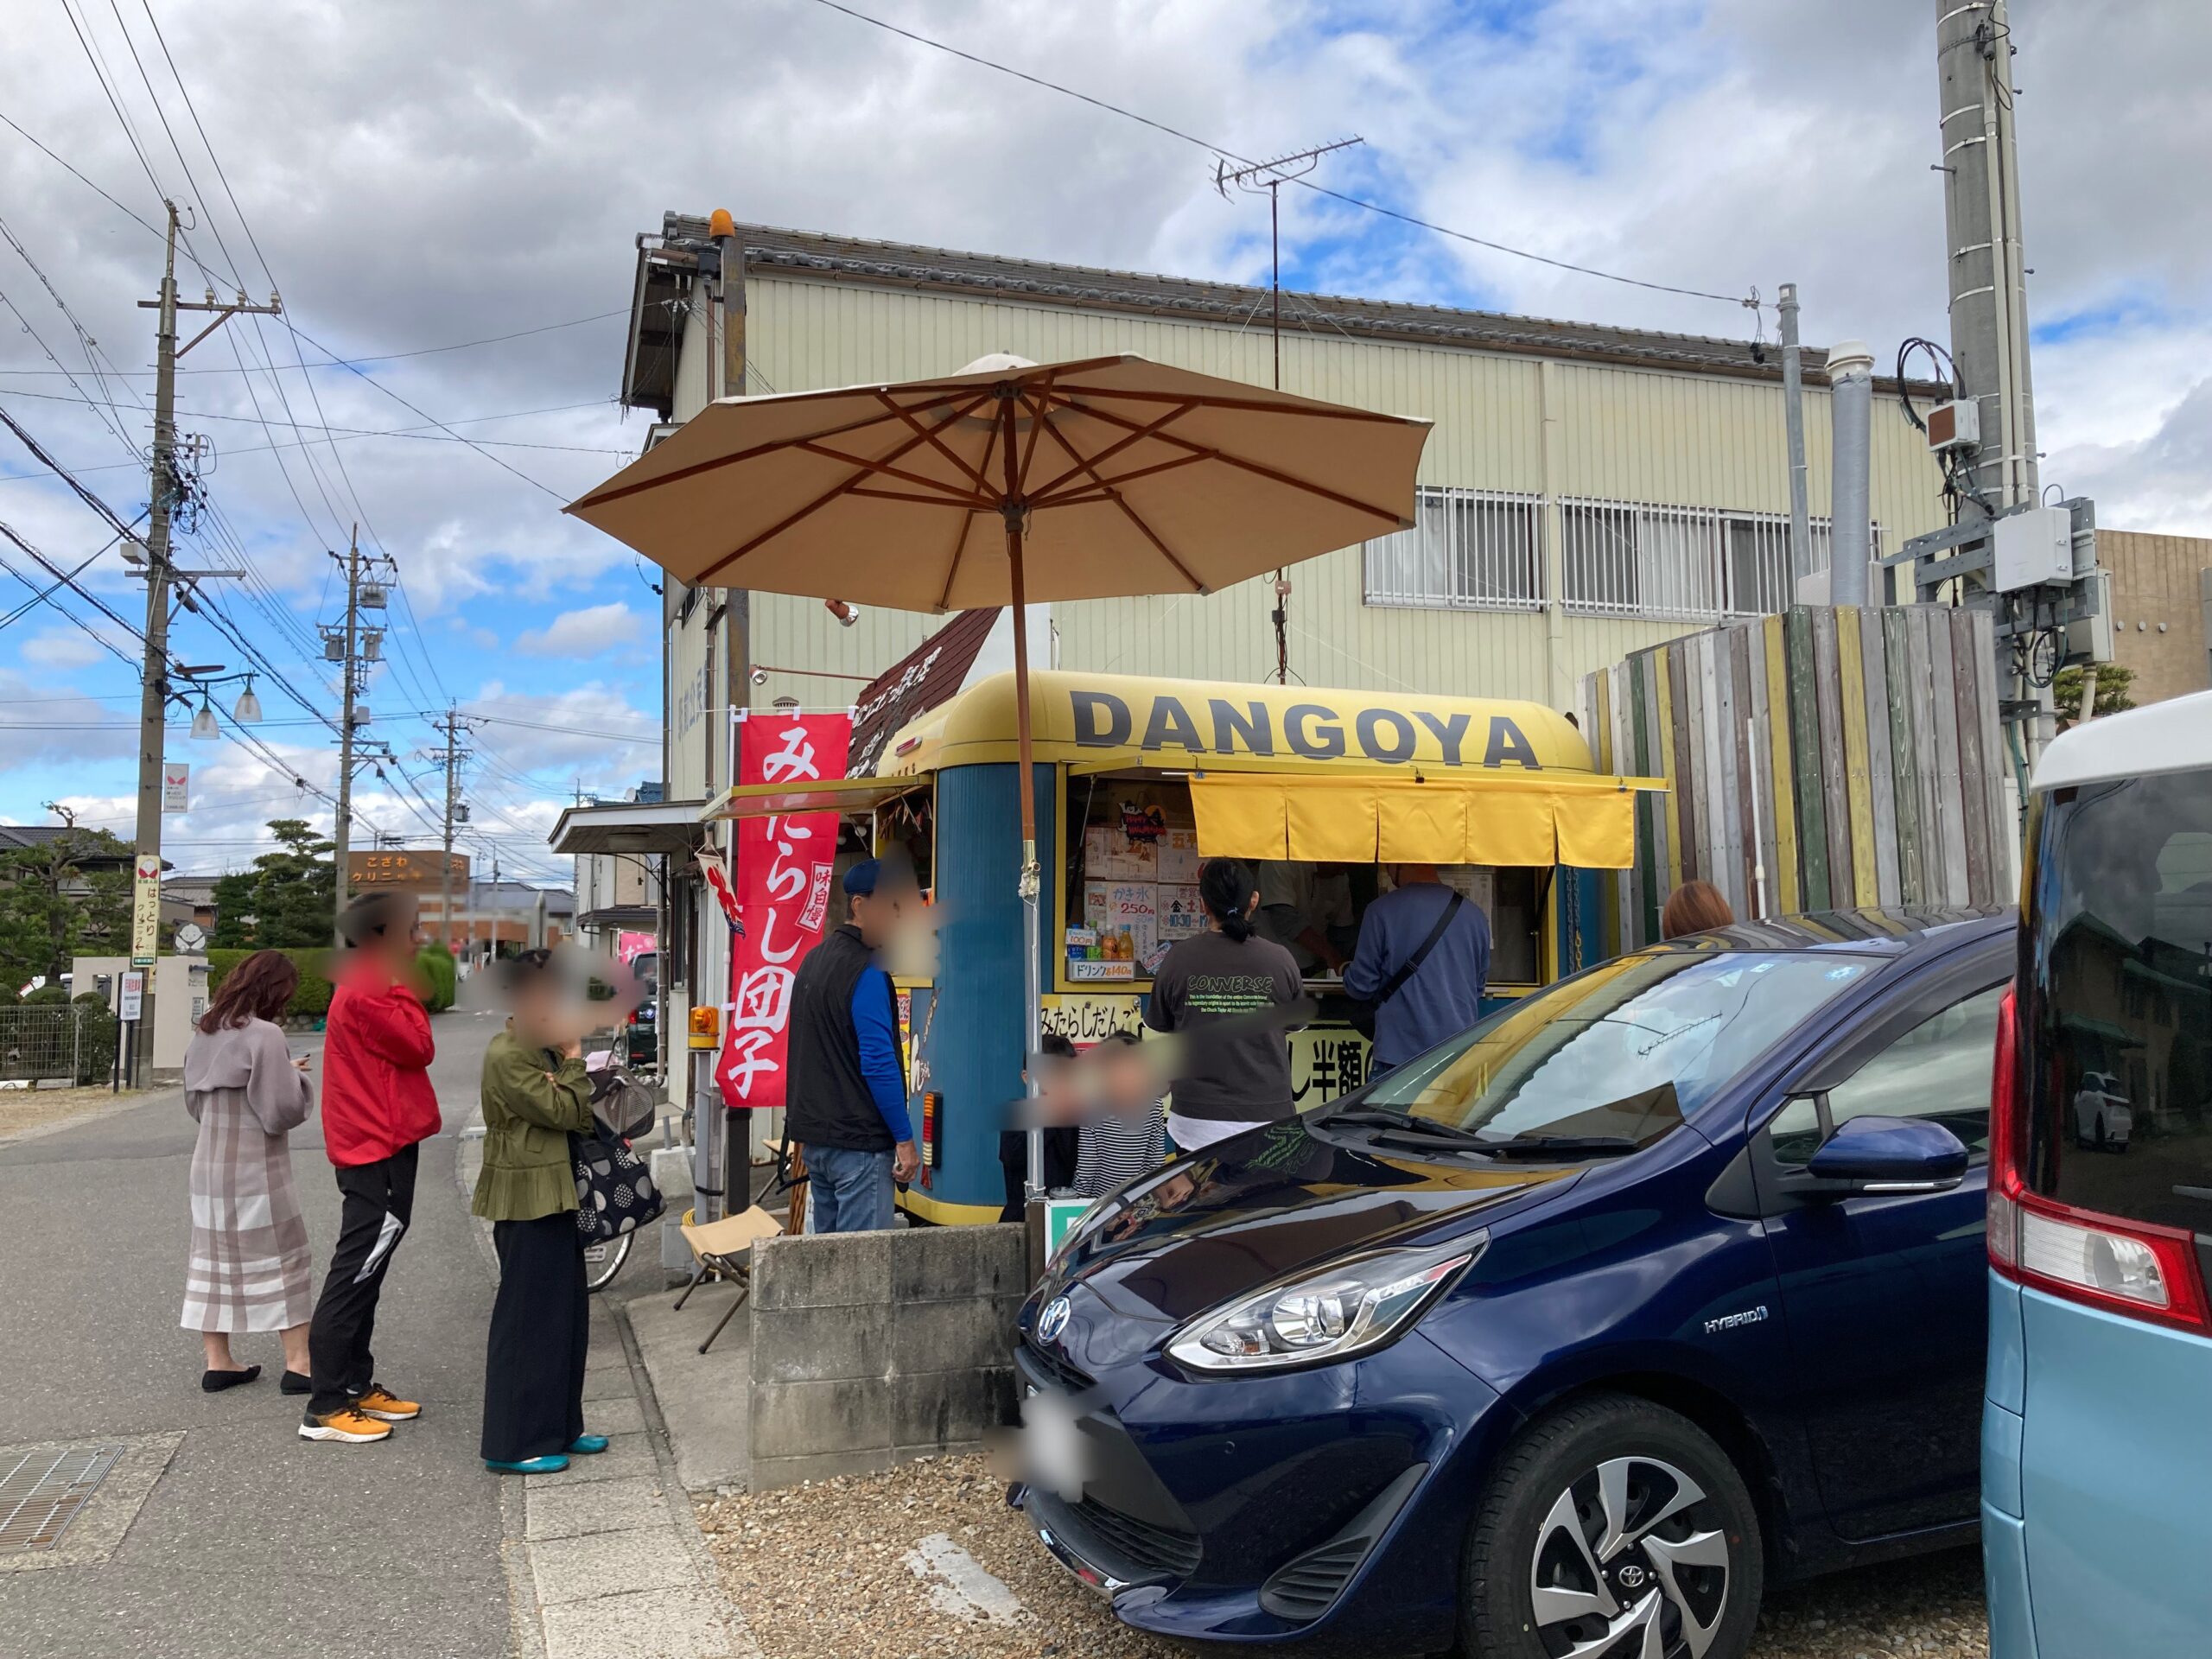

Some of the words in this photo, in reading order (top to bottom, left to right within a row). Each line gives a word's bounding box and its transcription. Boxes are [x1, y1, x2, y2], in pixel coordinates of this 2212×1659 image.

[1070, 690, 1542, 770] DANGOYA
[367, 856, 408, 868] こざわ
[804, 868, 832, 925] 味自慢
[1113, 886, 1150, 903] かき氷
[1179, 887, 1198, 899] 営業
[146, 887, 156, 936] はっとり
[1121, 902, 1155, 915] 250円
[1070, 936, 1093, 945] 100円
[1187, 975, 1274, 994] CONVERSE
[1704, 1310, 1758, 1334] HYBRID
